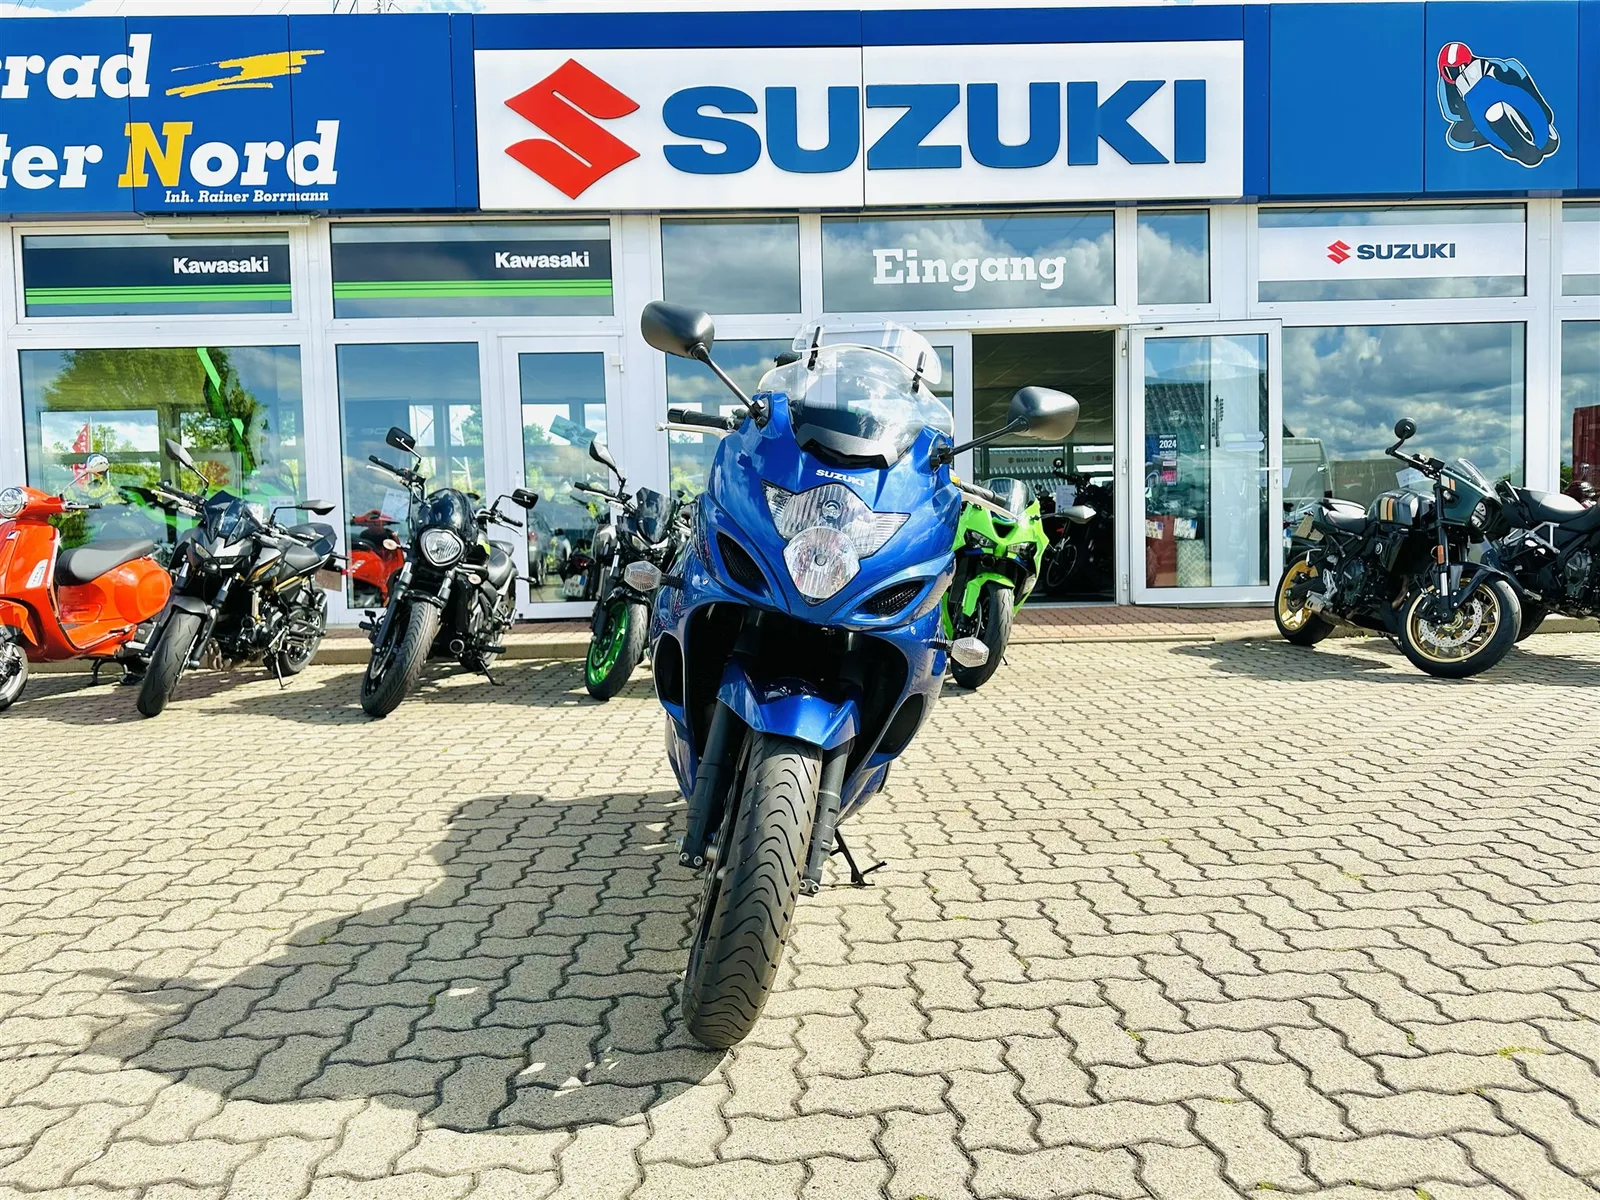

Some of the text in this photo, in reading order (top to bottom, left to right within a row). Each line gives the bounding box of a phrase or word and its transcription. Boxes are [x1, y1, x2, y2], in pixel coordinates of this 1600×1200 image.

[0, 33, 152, 99] rad
[662, 78, 1207, 175] SUZUKI
[117, 120, 340, 188] Nord
[164, 190, 329, 203] Inh. Rainer Borrmann
[495, 251, 590, 269] Kawasaki
[1356, 242, 1456, 260] SUZUKI
[173, 256, 269, 274] Kawasaki
[872, 248, 1067, 291] Eingang
[1159, 439, 1177, 449] 2024
[815, 469, 865, 487] SUZUKI
